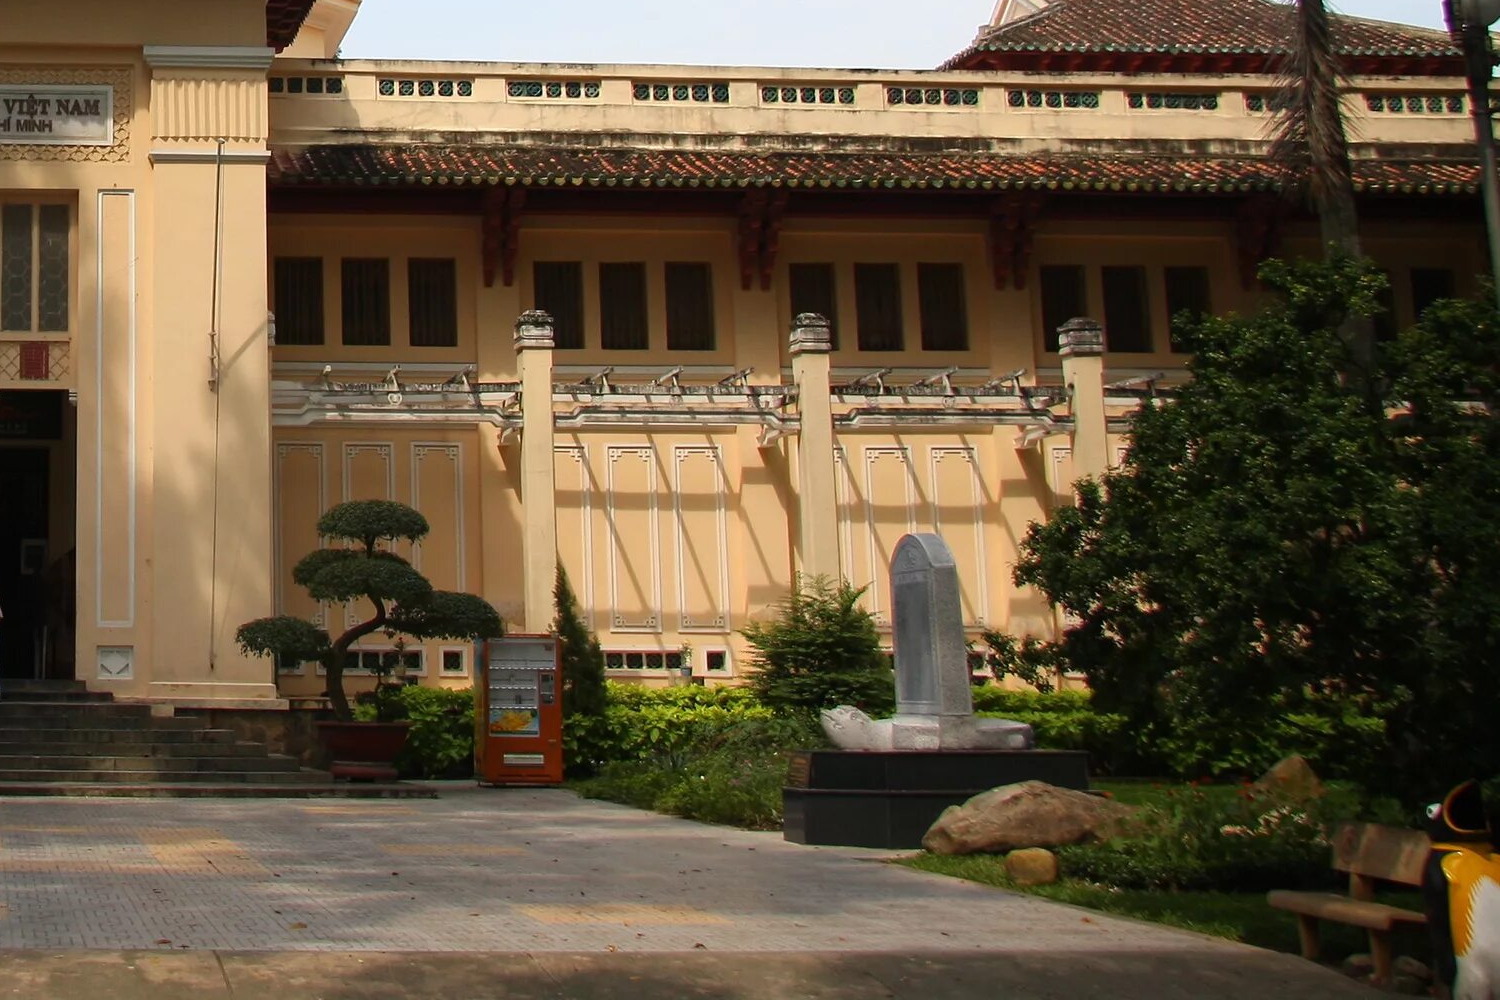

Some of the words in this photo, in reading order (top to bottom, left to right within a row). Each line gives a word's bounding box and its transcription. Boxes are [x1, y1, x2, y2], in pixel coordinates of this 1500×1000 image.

[3, 93, 51, 118] VIỆT
[55, 99, 101, 116] NAM
[16, 119, 53, 133] MINH
